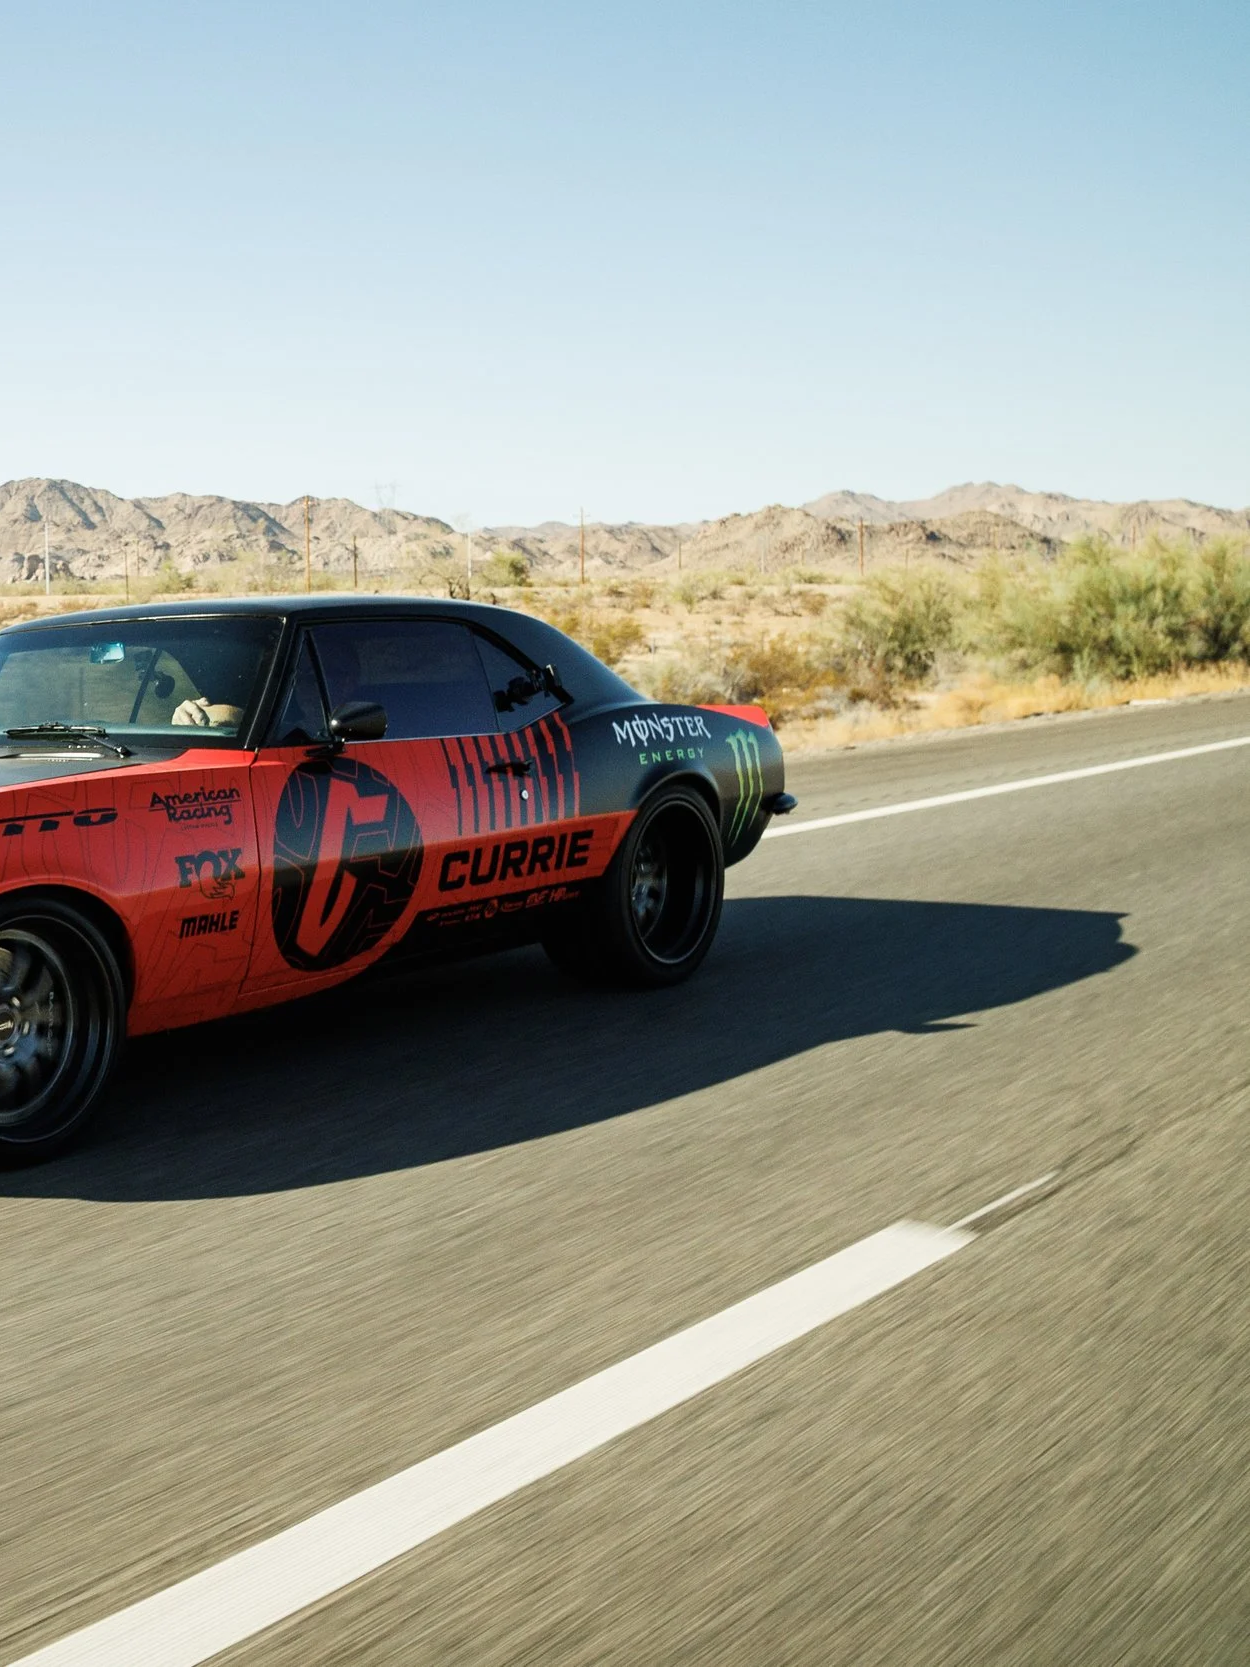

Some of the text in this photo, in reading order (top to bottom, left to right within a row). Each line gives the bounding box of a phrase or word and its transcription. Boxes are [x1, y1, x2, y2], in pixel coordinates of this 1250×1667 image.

[639, 747, 704, 765] ENERGY
[150, 786, 240, 808] American
[165, 802, 232, 825] Racing
[175, 848, 246, 891] FOX
[438, 830, 593, 892] CURRIE
[179, 910, 239, 939] MAHLE
